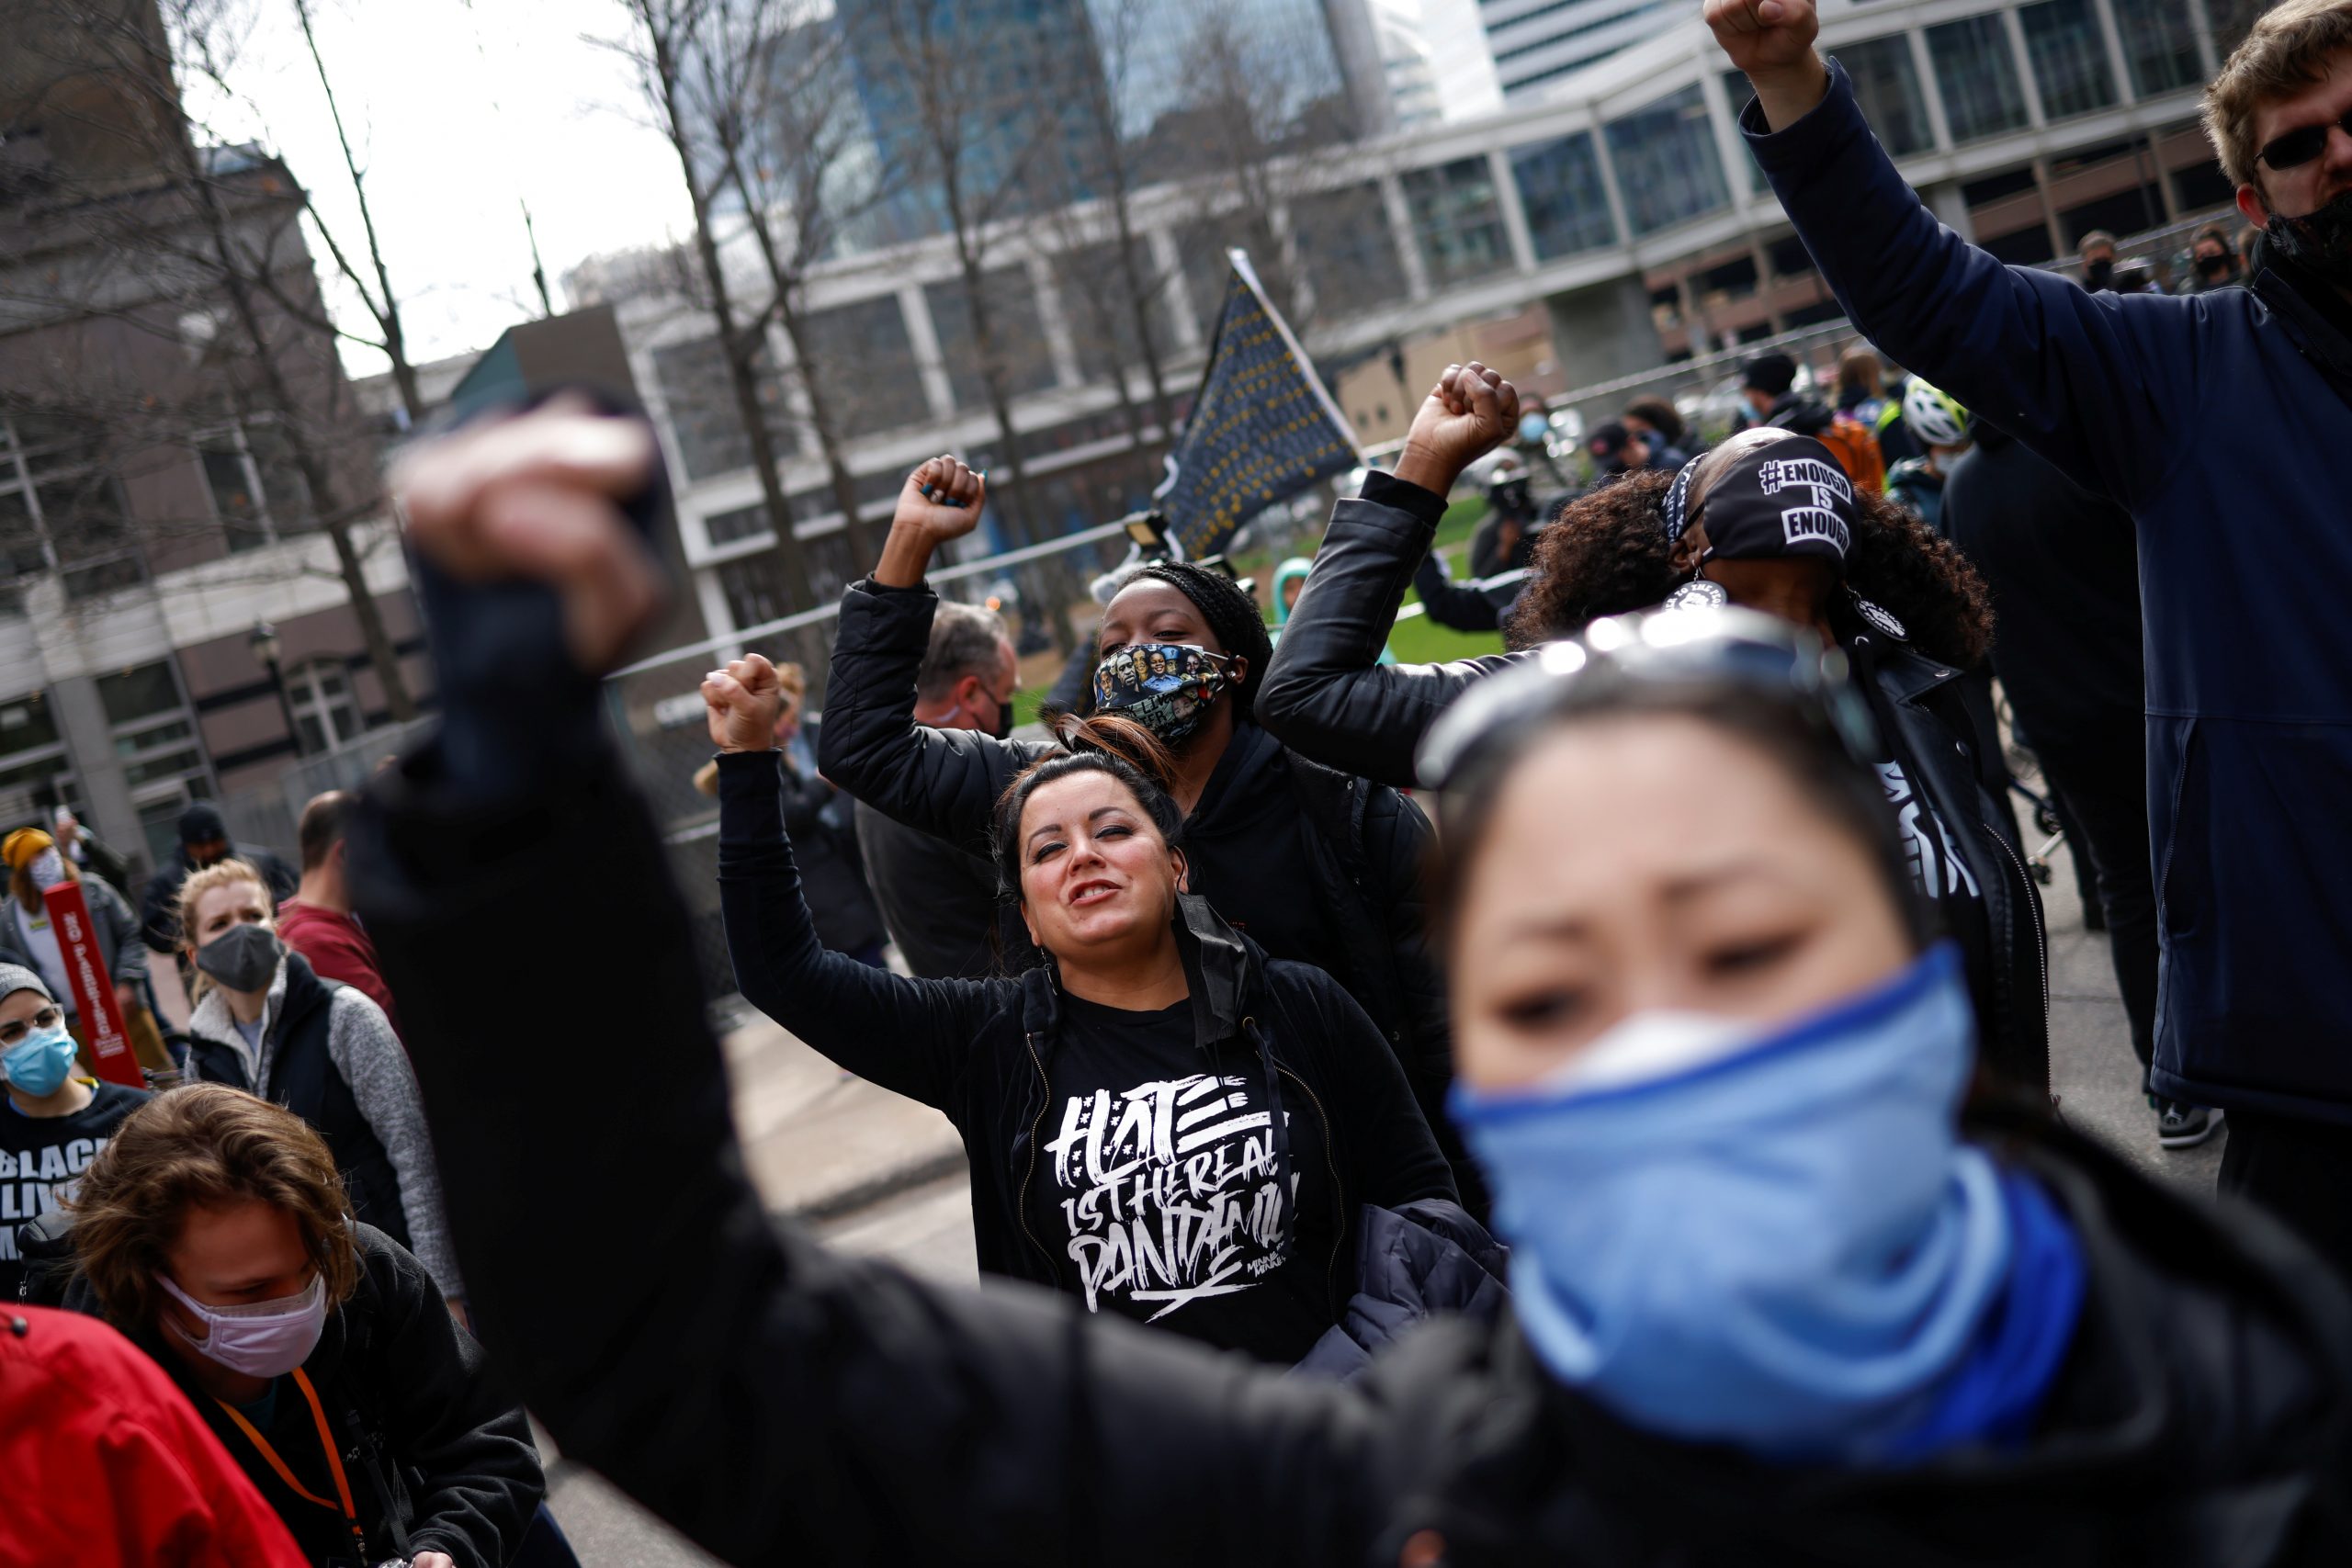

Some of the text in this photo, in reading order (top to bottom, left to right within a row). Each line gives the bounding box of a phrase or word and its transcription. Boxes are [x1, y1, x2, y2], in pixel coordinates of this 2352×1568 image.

[1759, 460, 1849, 501] #ENOUGH
[1811, 485, 1833, 510] IS
[1690, 583, 1713, 592] THE
[1044, 1074, 1289, 1187] HATE
[2, 1177, 83, 1220] LIV
[1060, 1128, 1279, 1236] IS THE REAL
